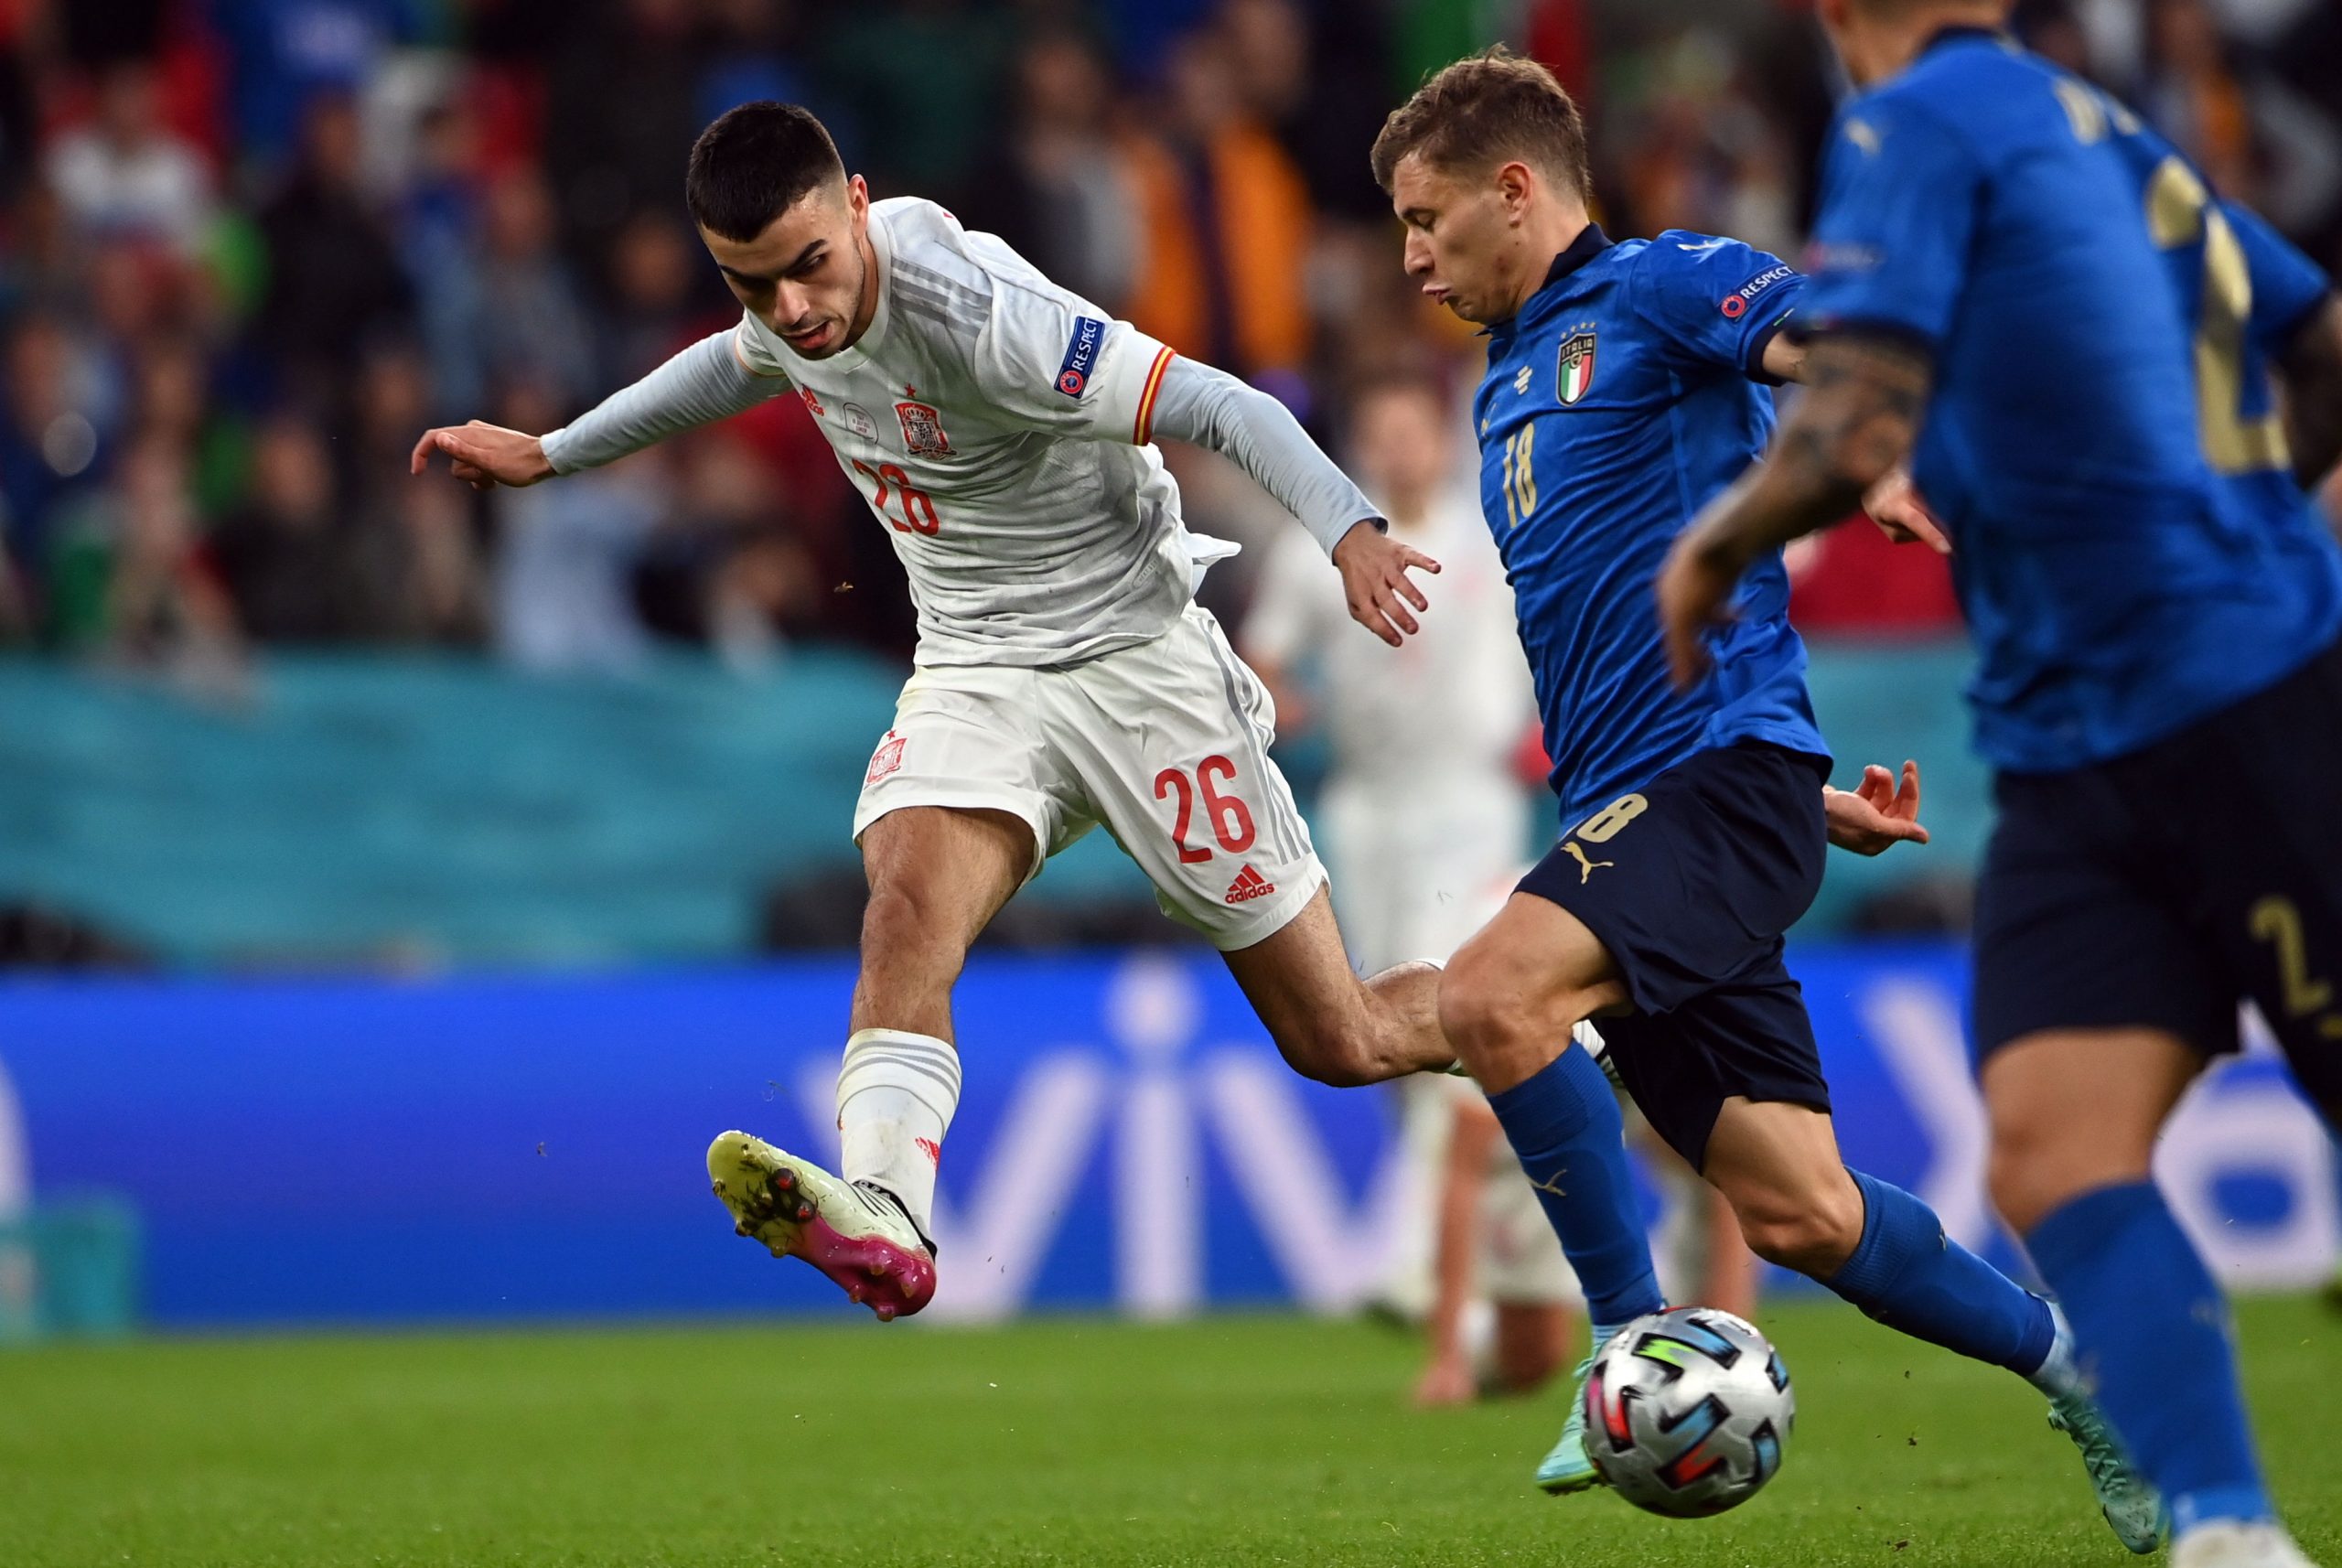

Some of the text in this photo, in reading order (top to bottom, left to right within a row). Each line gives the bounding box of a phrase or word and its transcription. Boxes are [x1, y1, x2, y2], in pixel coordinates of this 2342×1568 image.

[1737, 265, 1794, 299] RESPECT
[1071, 317, 1099, 371] RESPECT
[1561, 338, 1593, 359] ITALIA
[851, 458, 940, 536] 26
[1502, 422, 1537, 529] 18
[1155, 755, 1255, 864] 26
[1575, 792, 1649, 843] 8
[1224, 883, 1275, 905] adidas
[794, 956, 1450, 1319] viv
